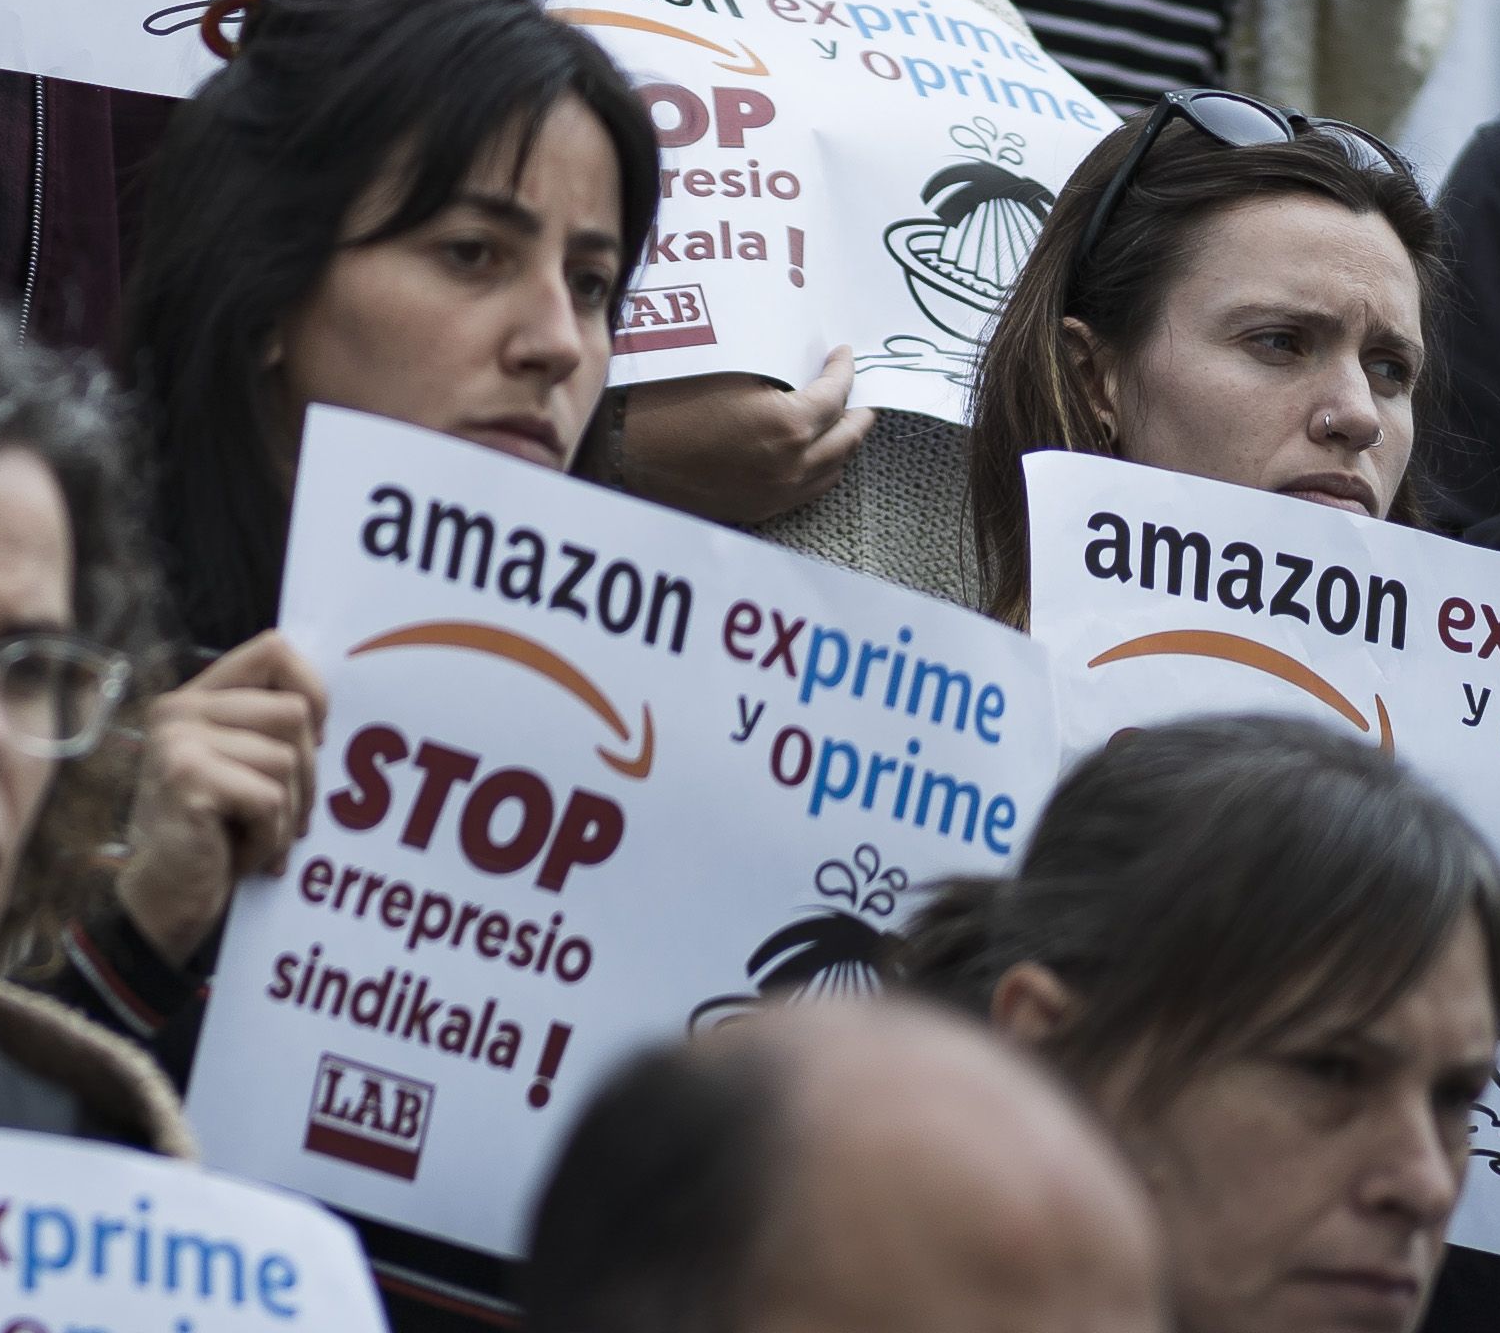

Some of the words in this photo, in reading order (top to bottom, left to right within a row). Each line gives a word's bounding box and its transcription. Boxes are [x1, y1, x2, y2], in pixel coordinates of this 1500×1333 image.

[645, 82, 777, 150] OP
[811, 37, 839, 62] y
[860, 48, 1104, 133] oprime
[660, 159, 802, 202] resio
[618, 290, 702, 330] AB
[363, 484, 692, 651] amazon
[722, 598, 1005, 745] exprime
[1084, 509, 1407, 646] amazon
[1460, 677, 1492, 728] y
[323, 723, 626, 893] STOP
[730, 695, 768, 745] y
[770, 713, 1019, 857] oprime
[299, 857, 592, 983] errepresio
[317, 1067, 430, 1146] LAB
